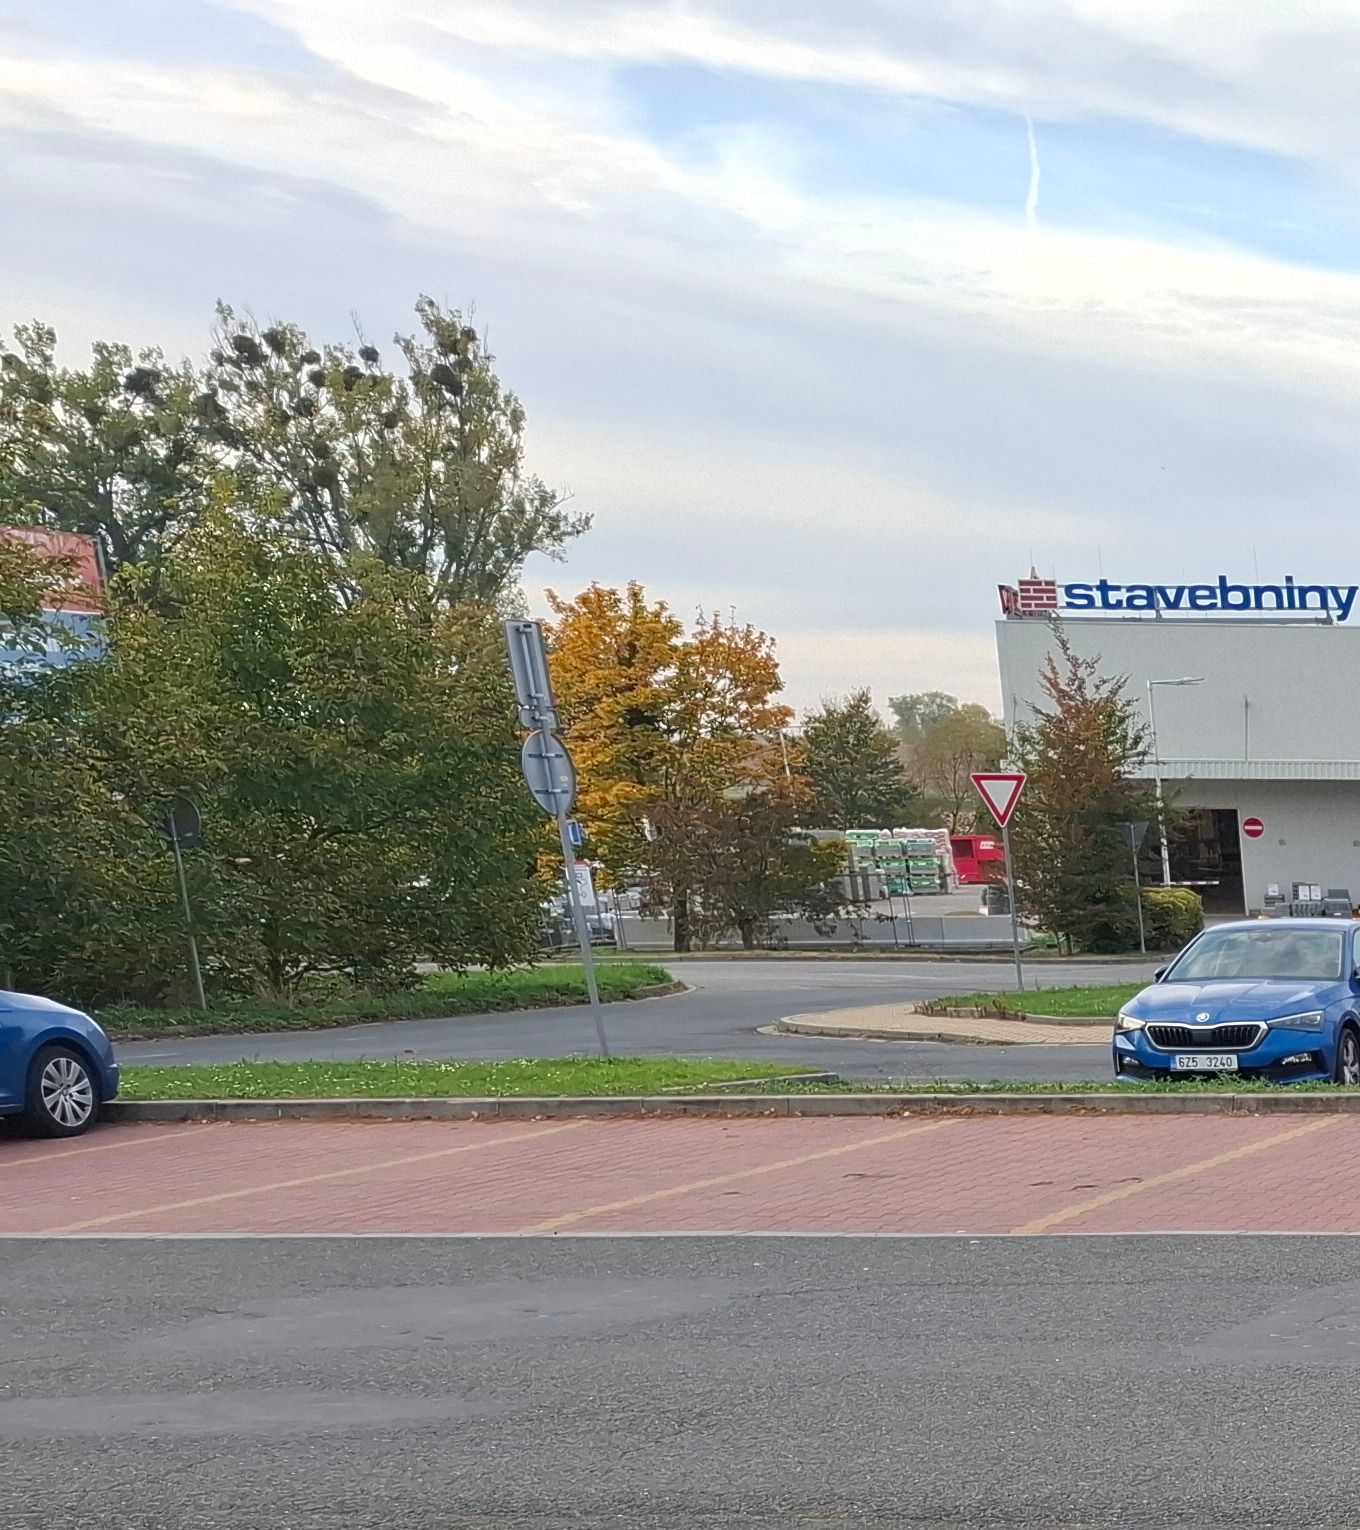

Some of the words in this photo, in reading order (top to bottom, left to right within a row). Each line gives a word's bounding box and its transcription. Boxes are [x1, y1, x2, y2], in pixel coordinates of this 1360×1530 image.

[1063, 575, 1359, 621] stavebniny
[1178, 1056, 1199, 1068] 6Z5
[1206, 1056, 1233, 1068] 3240
